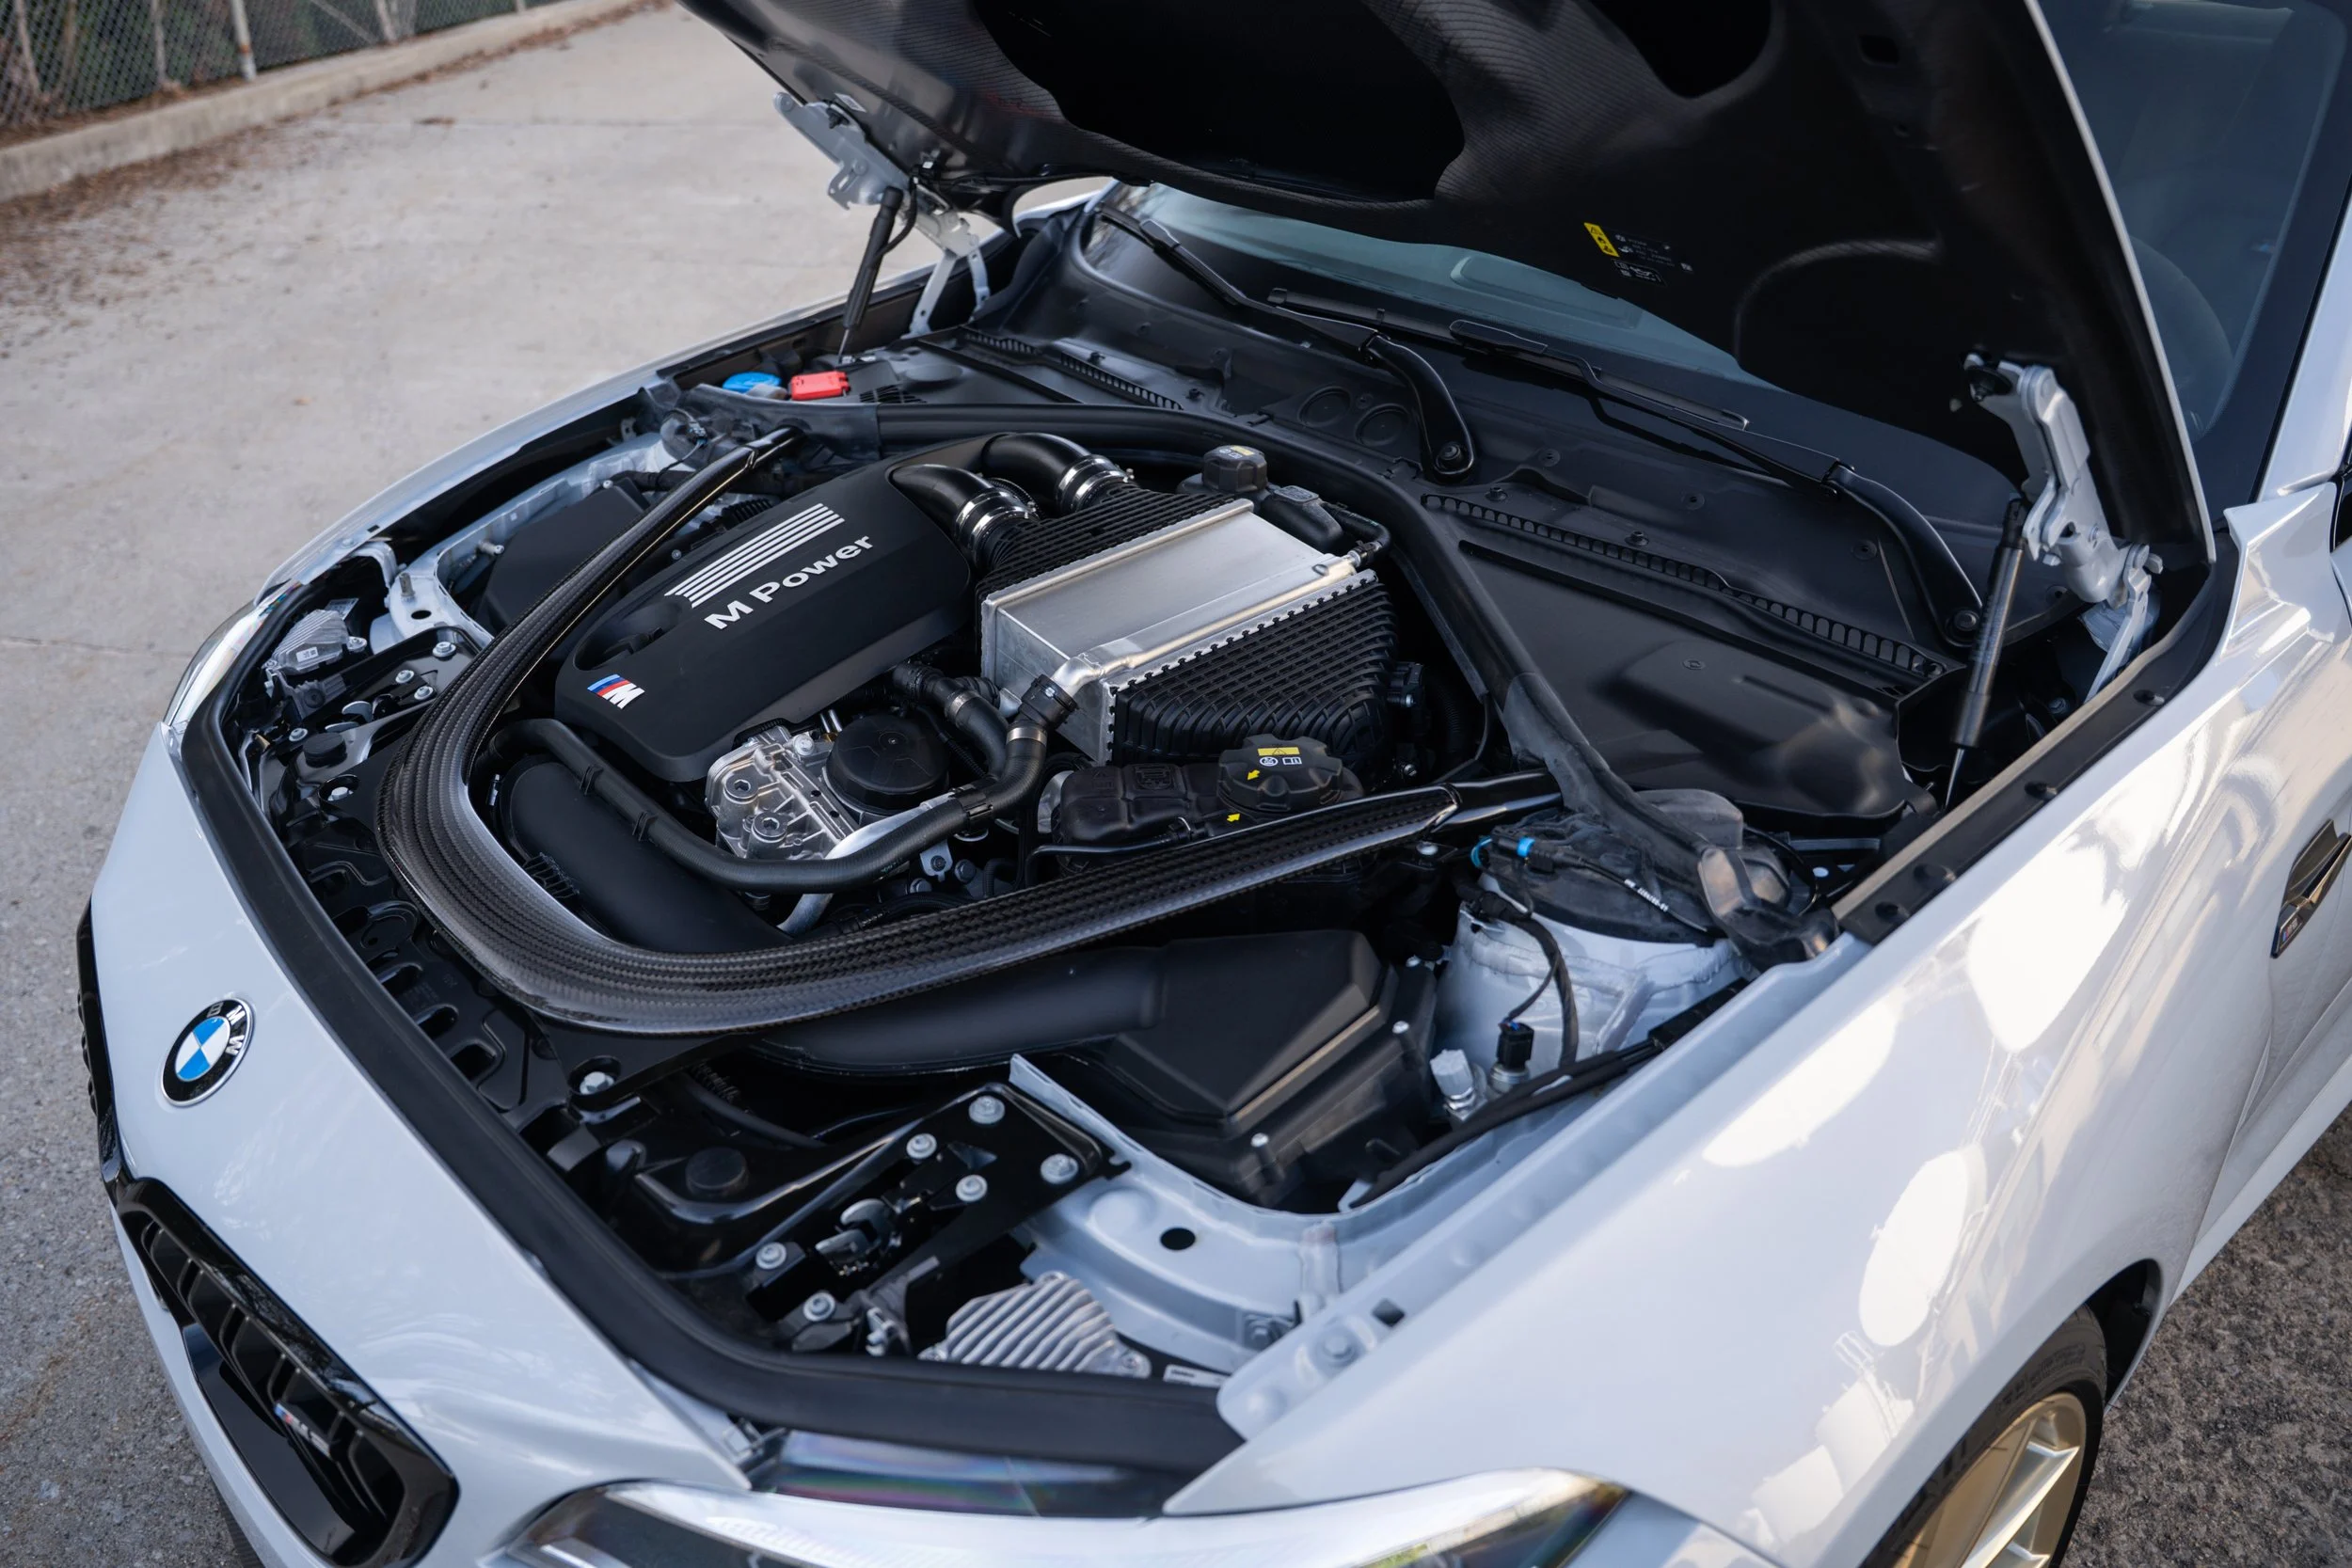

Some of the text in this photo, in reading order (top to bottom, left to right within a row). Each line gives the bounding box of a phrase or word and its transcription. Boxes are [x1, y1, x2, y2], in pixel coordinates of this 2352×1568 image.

[704, 535, 873, 629] M Power
[601, 682, 645, 709] M
[206, 1002, 246, 1056] BMW
